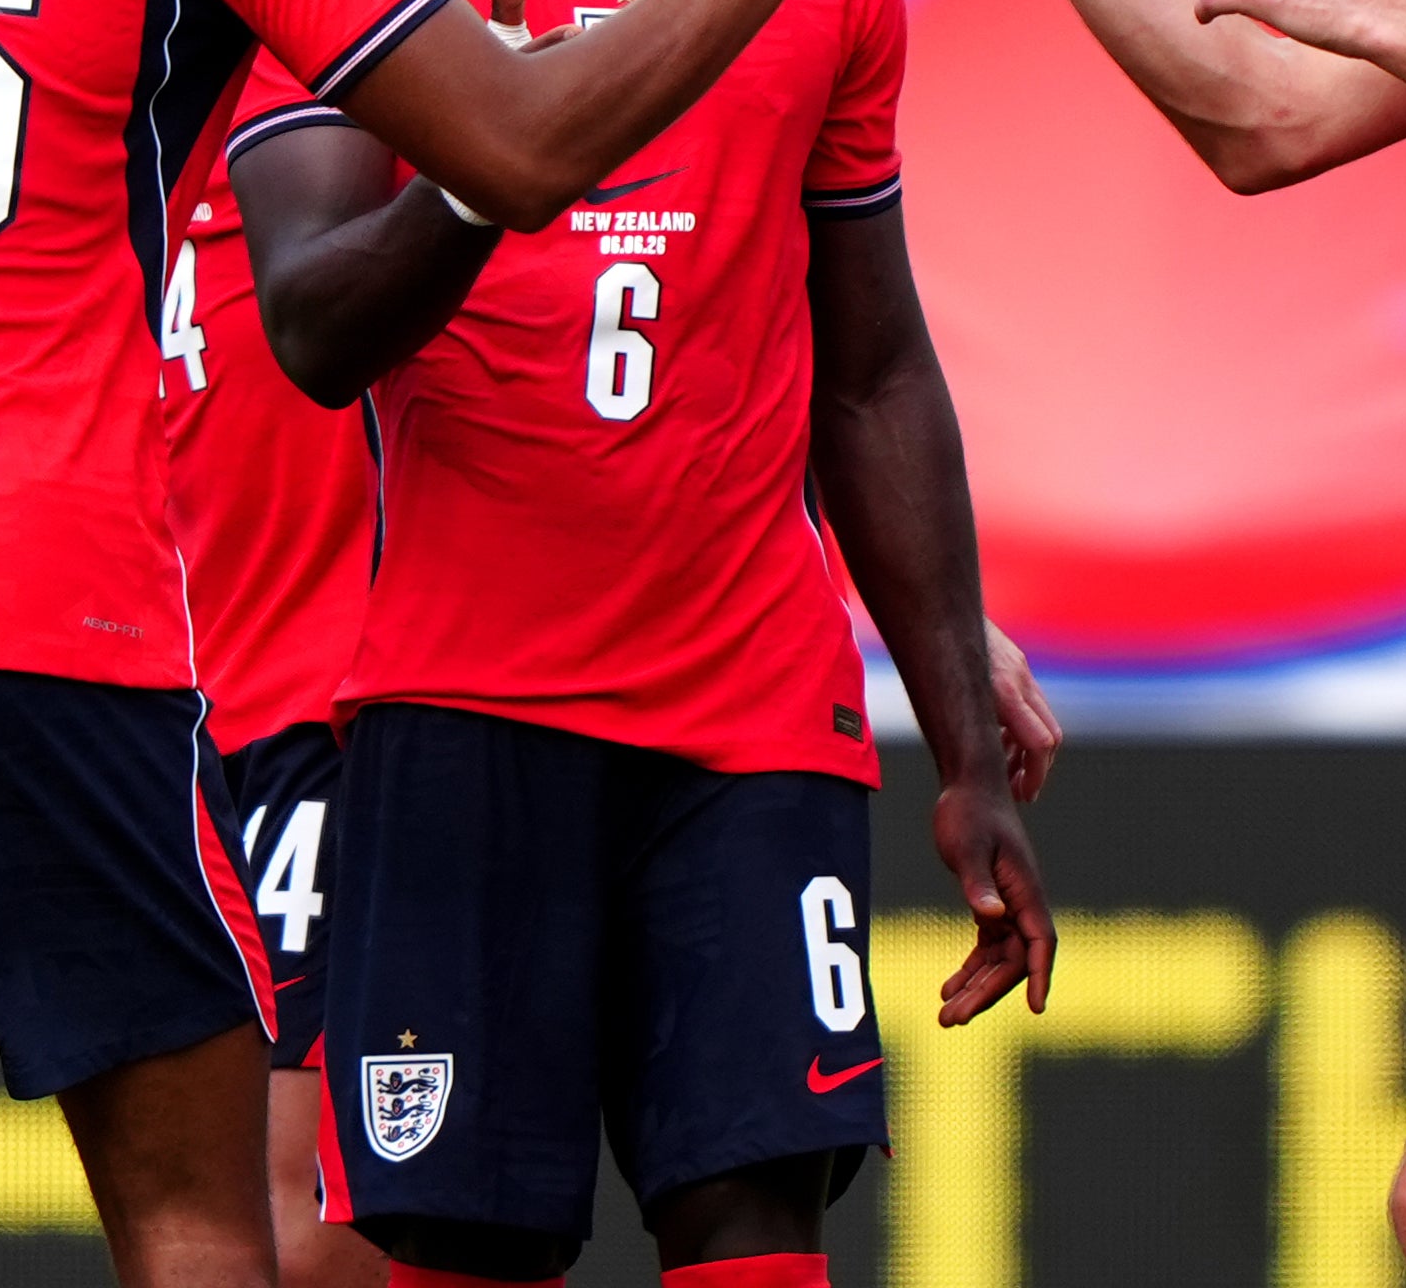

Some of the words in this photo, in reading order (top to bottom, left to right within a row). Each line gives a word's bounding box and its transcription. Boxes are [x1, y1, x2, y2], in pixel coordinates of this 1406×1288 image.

[570, 211, 612, 232] NEW
[613, 211, 696, 232] ZEALAND
[599, 234, 667, 255] 06.06.26
[159, 239, 207, 399] 4
[585, 262, 660, 421] 6
[800, 876, 866, 1032] 6
